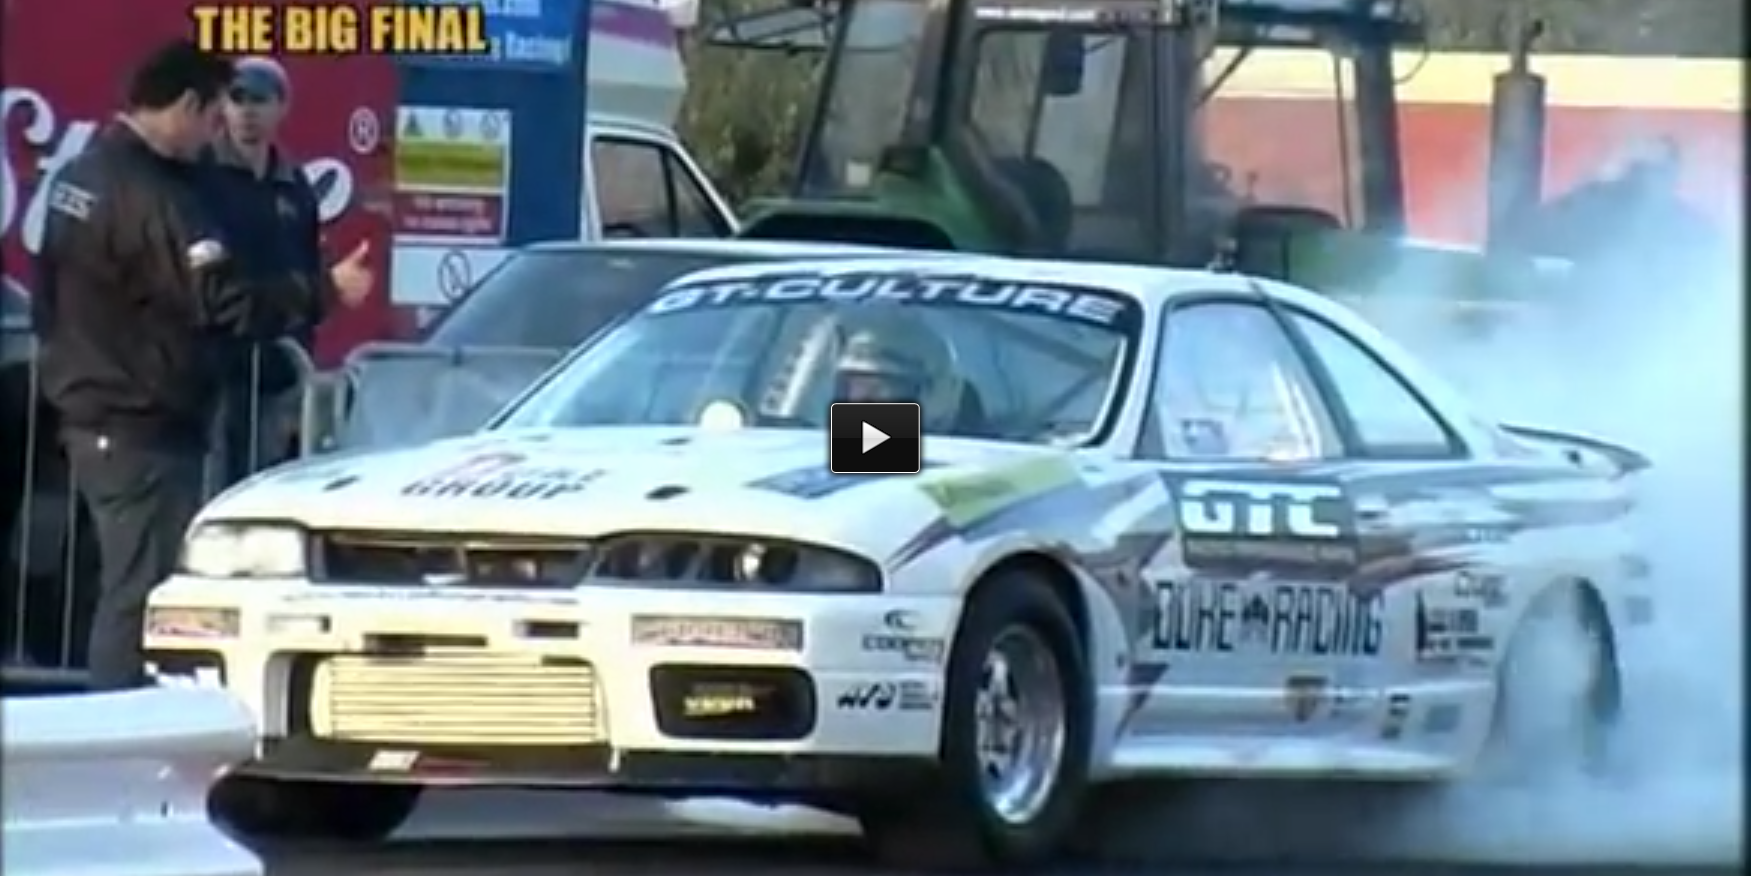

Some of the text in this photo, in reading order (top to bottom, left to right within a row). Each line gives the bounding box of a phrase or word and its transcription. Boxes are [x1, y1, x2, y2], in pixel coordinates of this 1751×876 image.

[647, 276, 1124, 323] GT-CULTURE
[1181, 479, 1341, 536] GTC
[1153, 580, 1236, 650] DUKE
[1272, 584, 1384, 655] RACING
